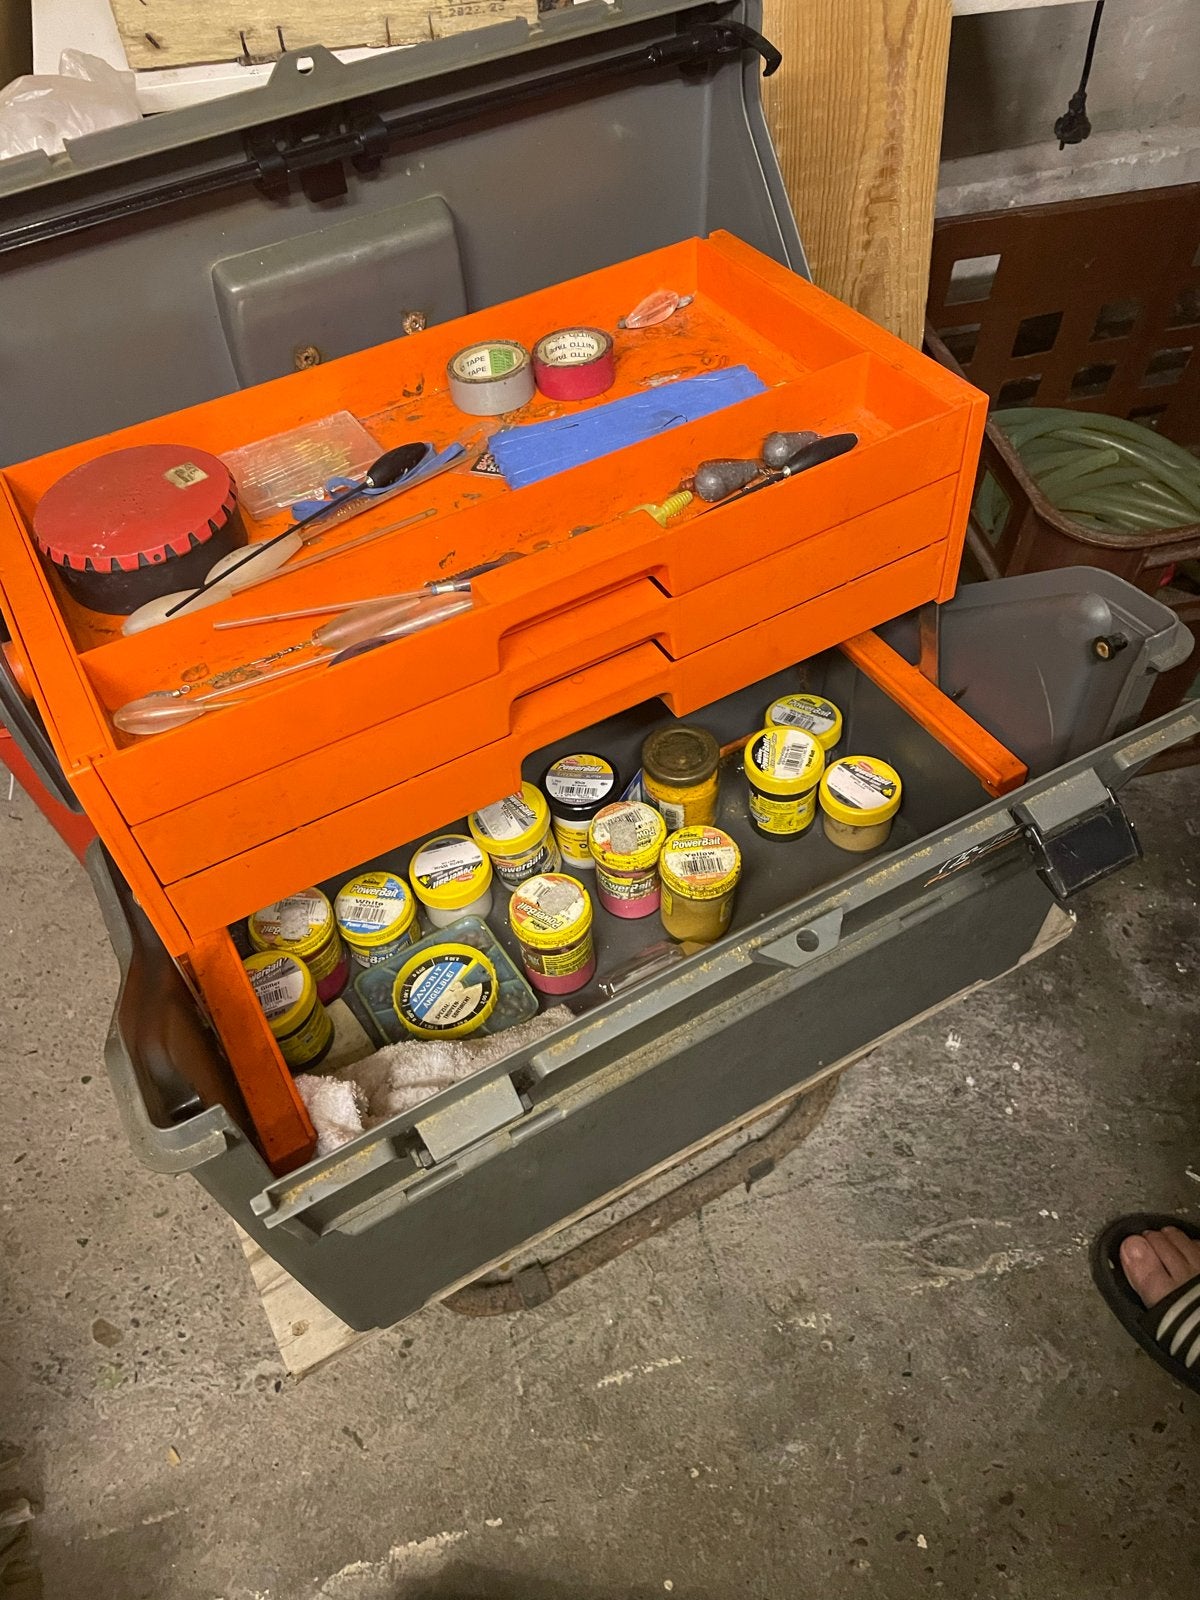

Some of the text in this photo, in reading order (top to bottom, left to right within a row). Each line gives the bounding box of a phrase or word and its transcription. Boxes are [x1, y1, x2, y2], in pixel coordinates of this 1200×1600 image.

[569, 340, 595, 350] NITTO
[466, 354, 486, 369] TAPE
[468, 365, 488, 377] TAPE
[787, 699, 832, 717] PowerBait
[557, 763, 603, 773] PowerBait
[501, 803, 514, 819] White
[508, 795, 537, 820] owerBait
[671, 836, 721, 850] PowerBait
[497, 845, 545, 874] PowerBait
[432, 865, 474, 889] PowerBait
[352, 883, 399, 898] PowerBait
[355, 898, 384, 906] White
[517, 902, 564, 930] PowerBait
[260, 981, 280, 991] Glitter
[412, 965, 442, 1003] FAVORIT
[423, 970, 455, 1009] ANGELBLEI
